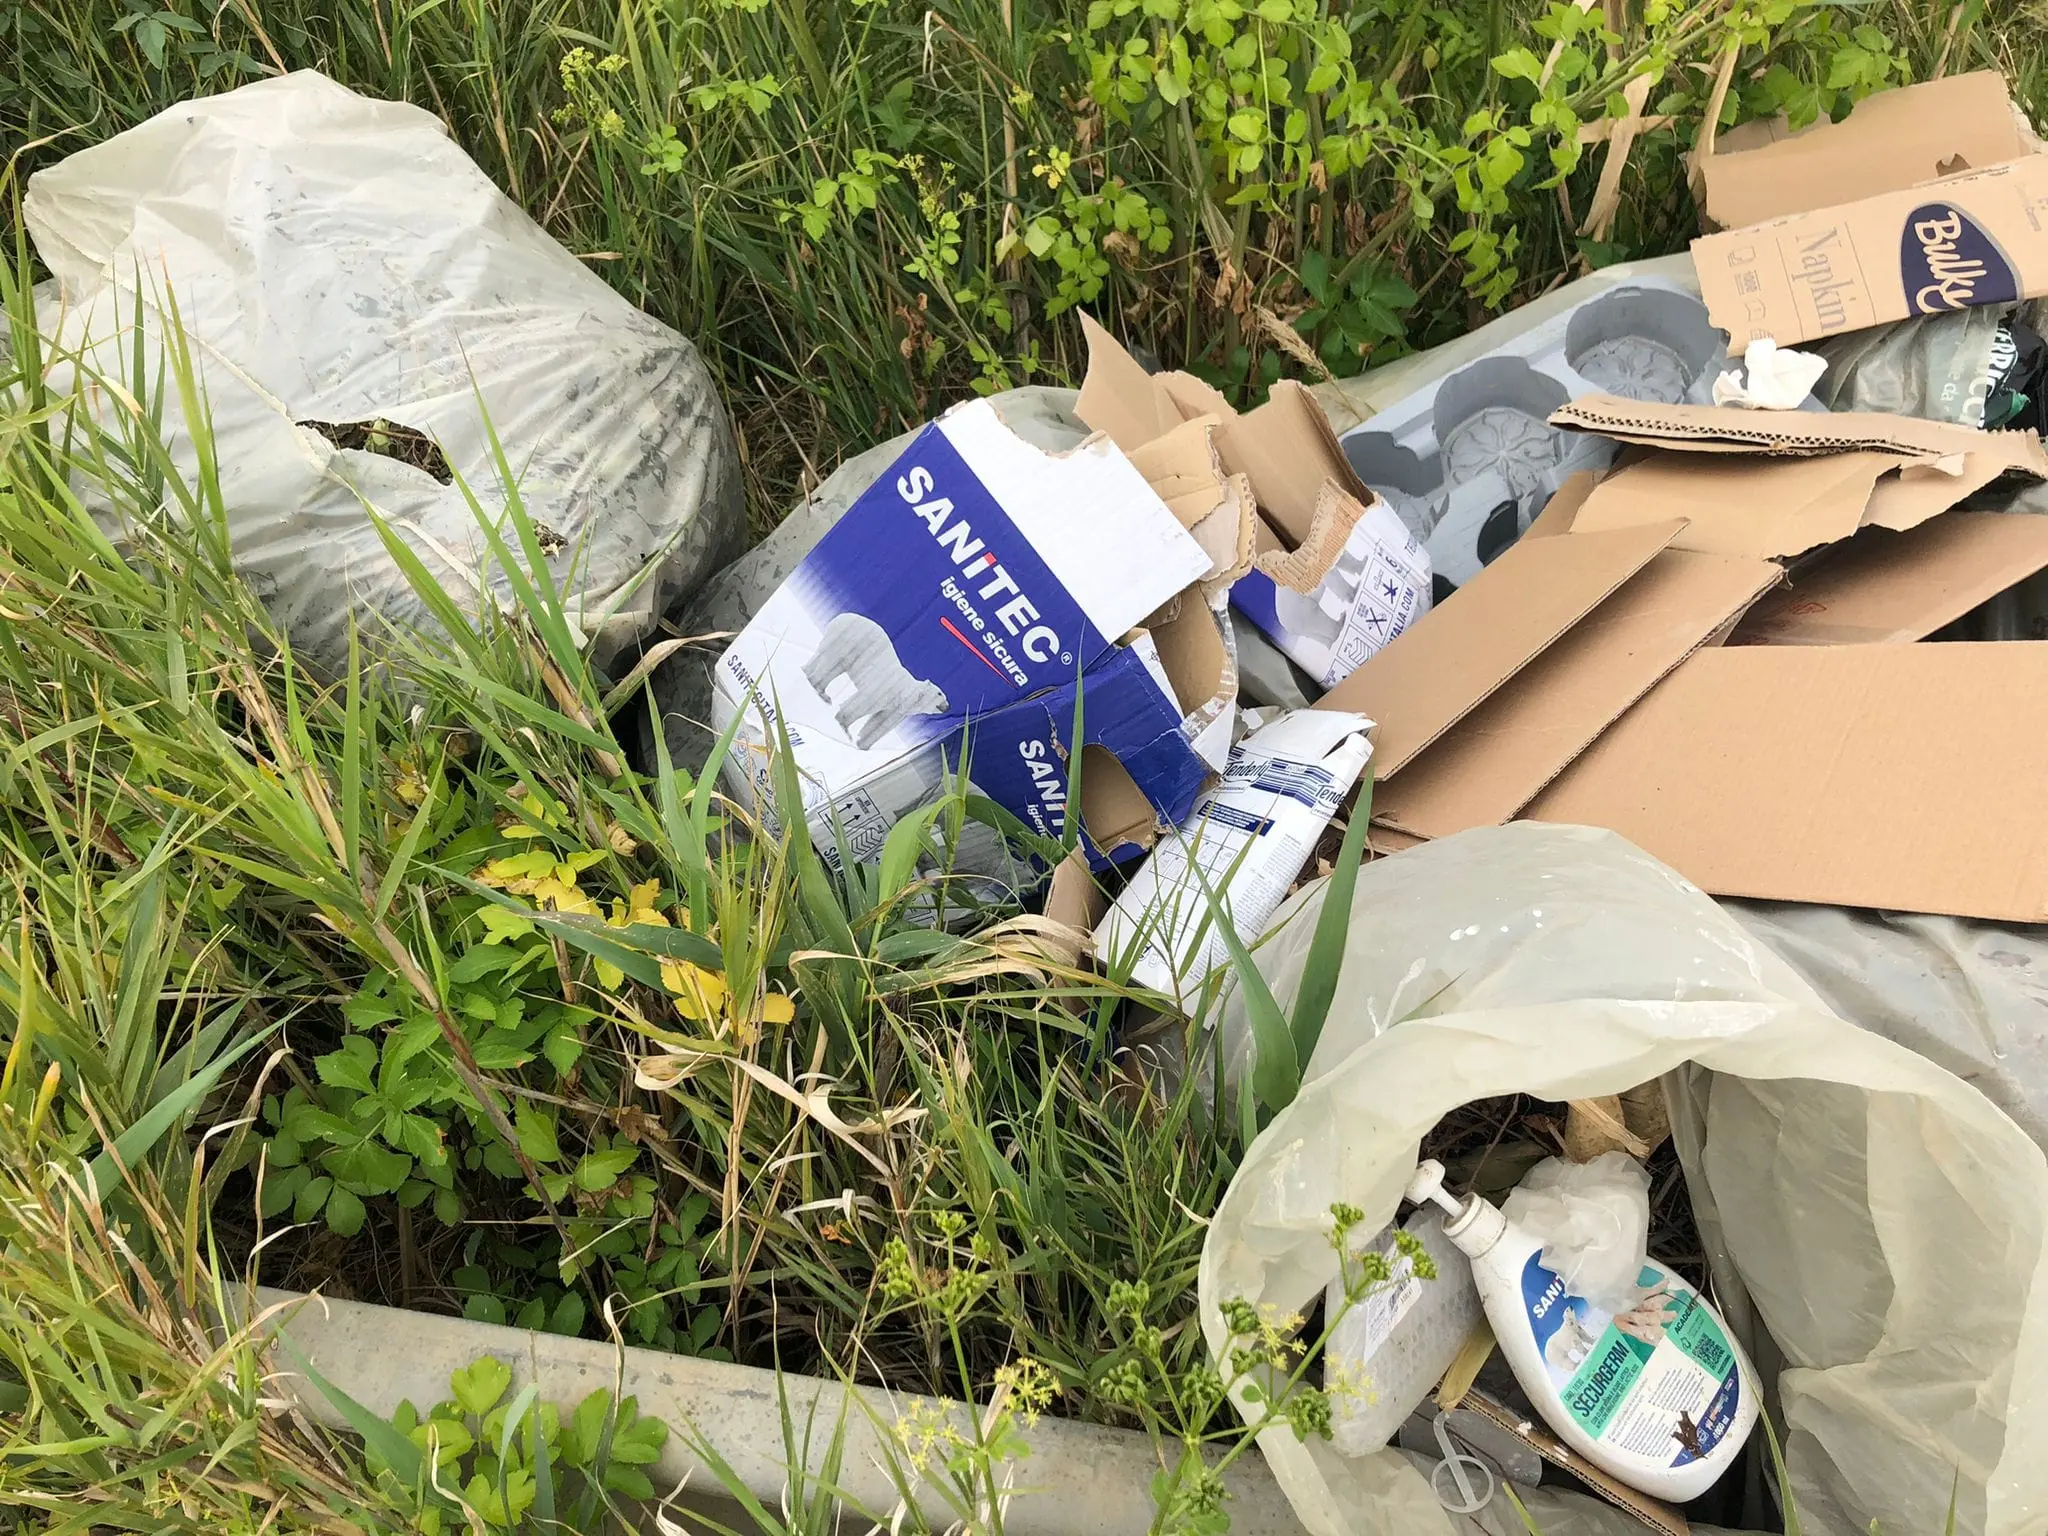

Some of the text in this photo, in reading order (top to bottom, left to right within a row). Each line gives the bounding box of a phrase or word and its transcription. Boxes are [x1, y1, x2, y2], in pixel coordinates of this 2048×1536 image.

[1791, 227, 1857, 333] Napkin
[1913, 210, 1987, 314] Bulky
[896, 466, 1060, 663] SANITEC
[940, 576, 1029, 687] igiene sicura
[1222, 760, 1271, 783] Tenderly
[1533, 1279, 1562, 1319] SANI
[1572, 1339, 1630, 1418] SECURGERM
